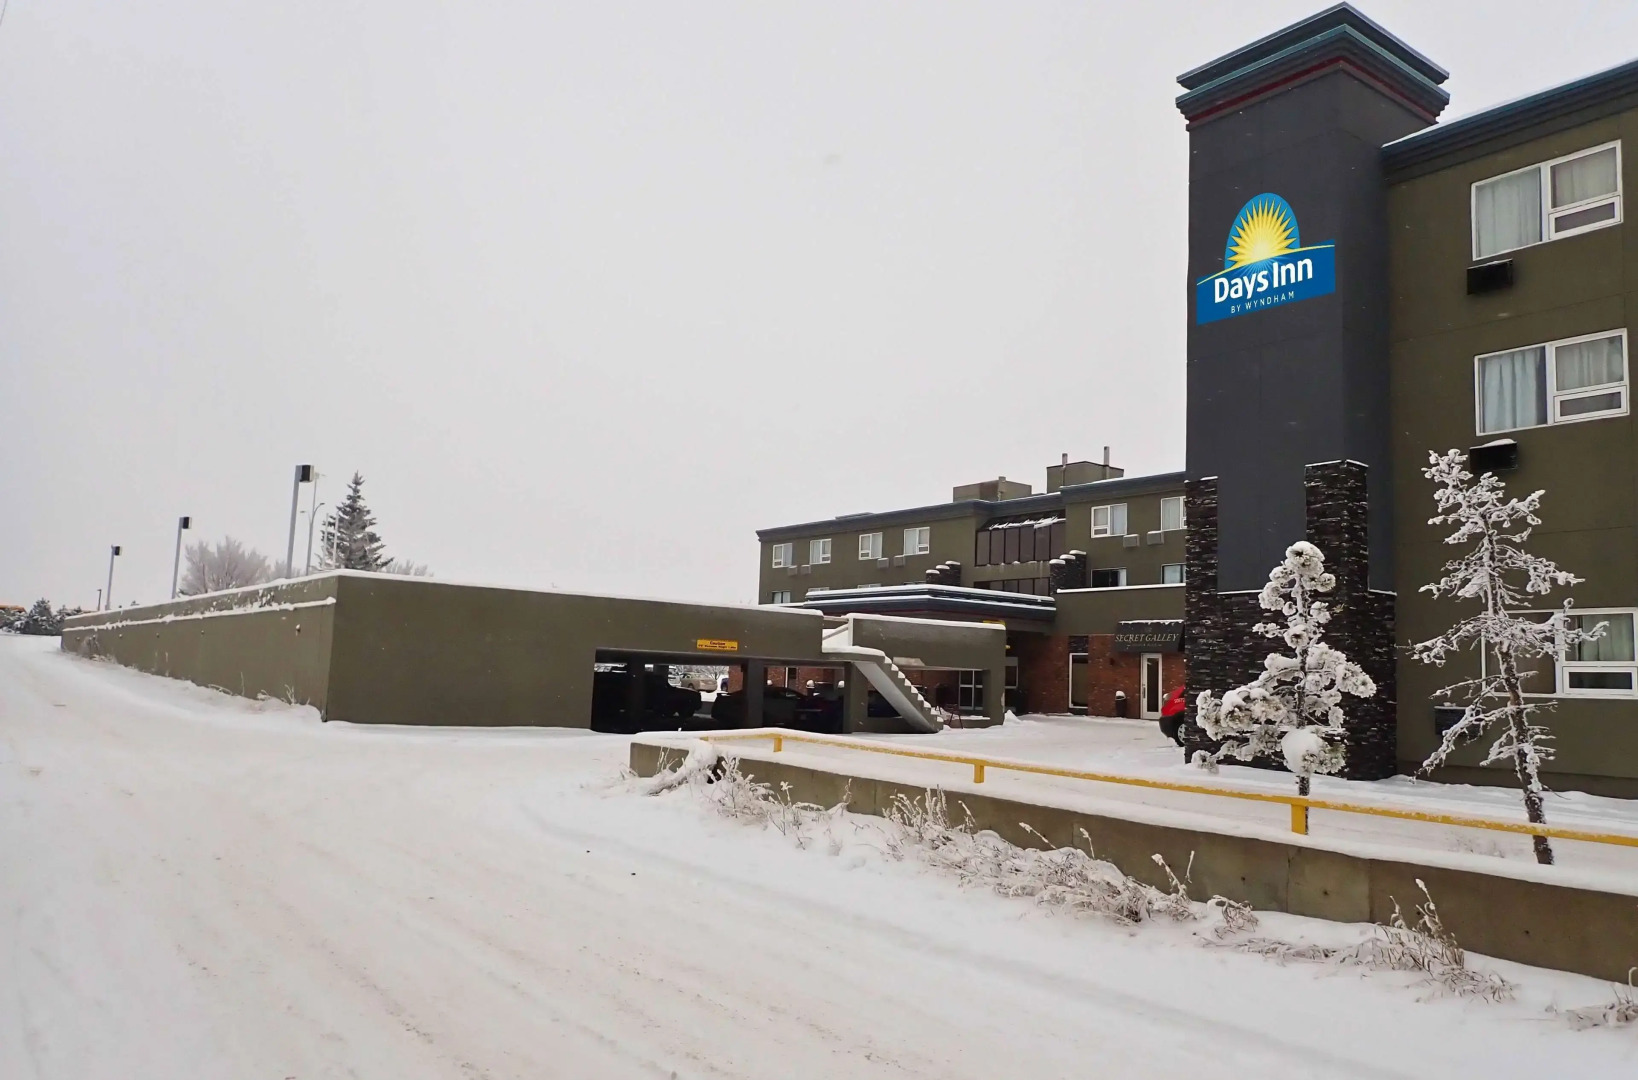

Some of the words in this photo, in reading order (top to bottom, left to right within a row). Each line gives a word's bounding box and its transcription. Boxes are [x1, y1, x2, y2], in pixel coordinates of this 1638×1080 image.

[1214, 270, 1269, 303] Days
[1273, 258, 1313, 288] Inn
[1231, 305, 1241, 313] BY
[1245, 291, 1295, 309] WYNDHAM
[1115, 633, 1144, 642] SECRET
[1145, 633, 1179, 641] GALLEY
